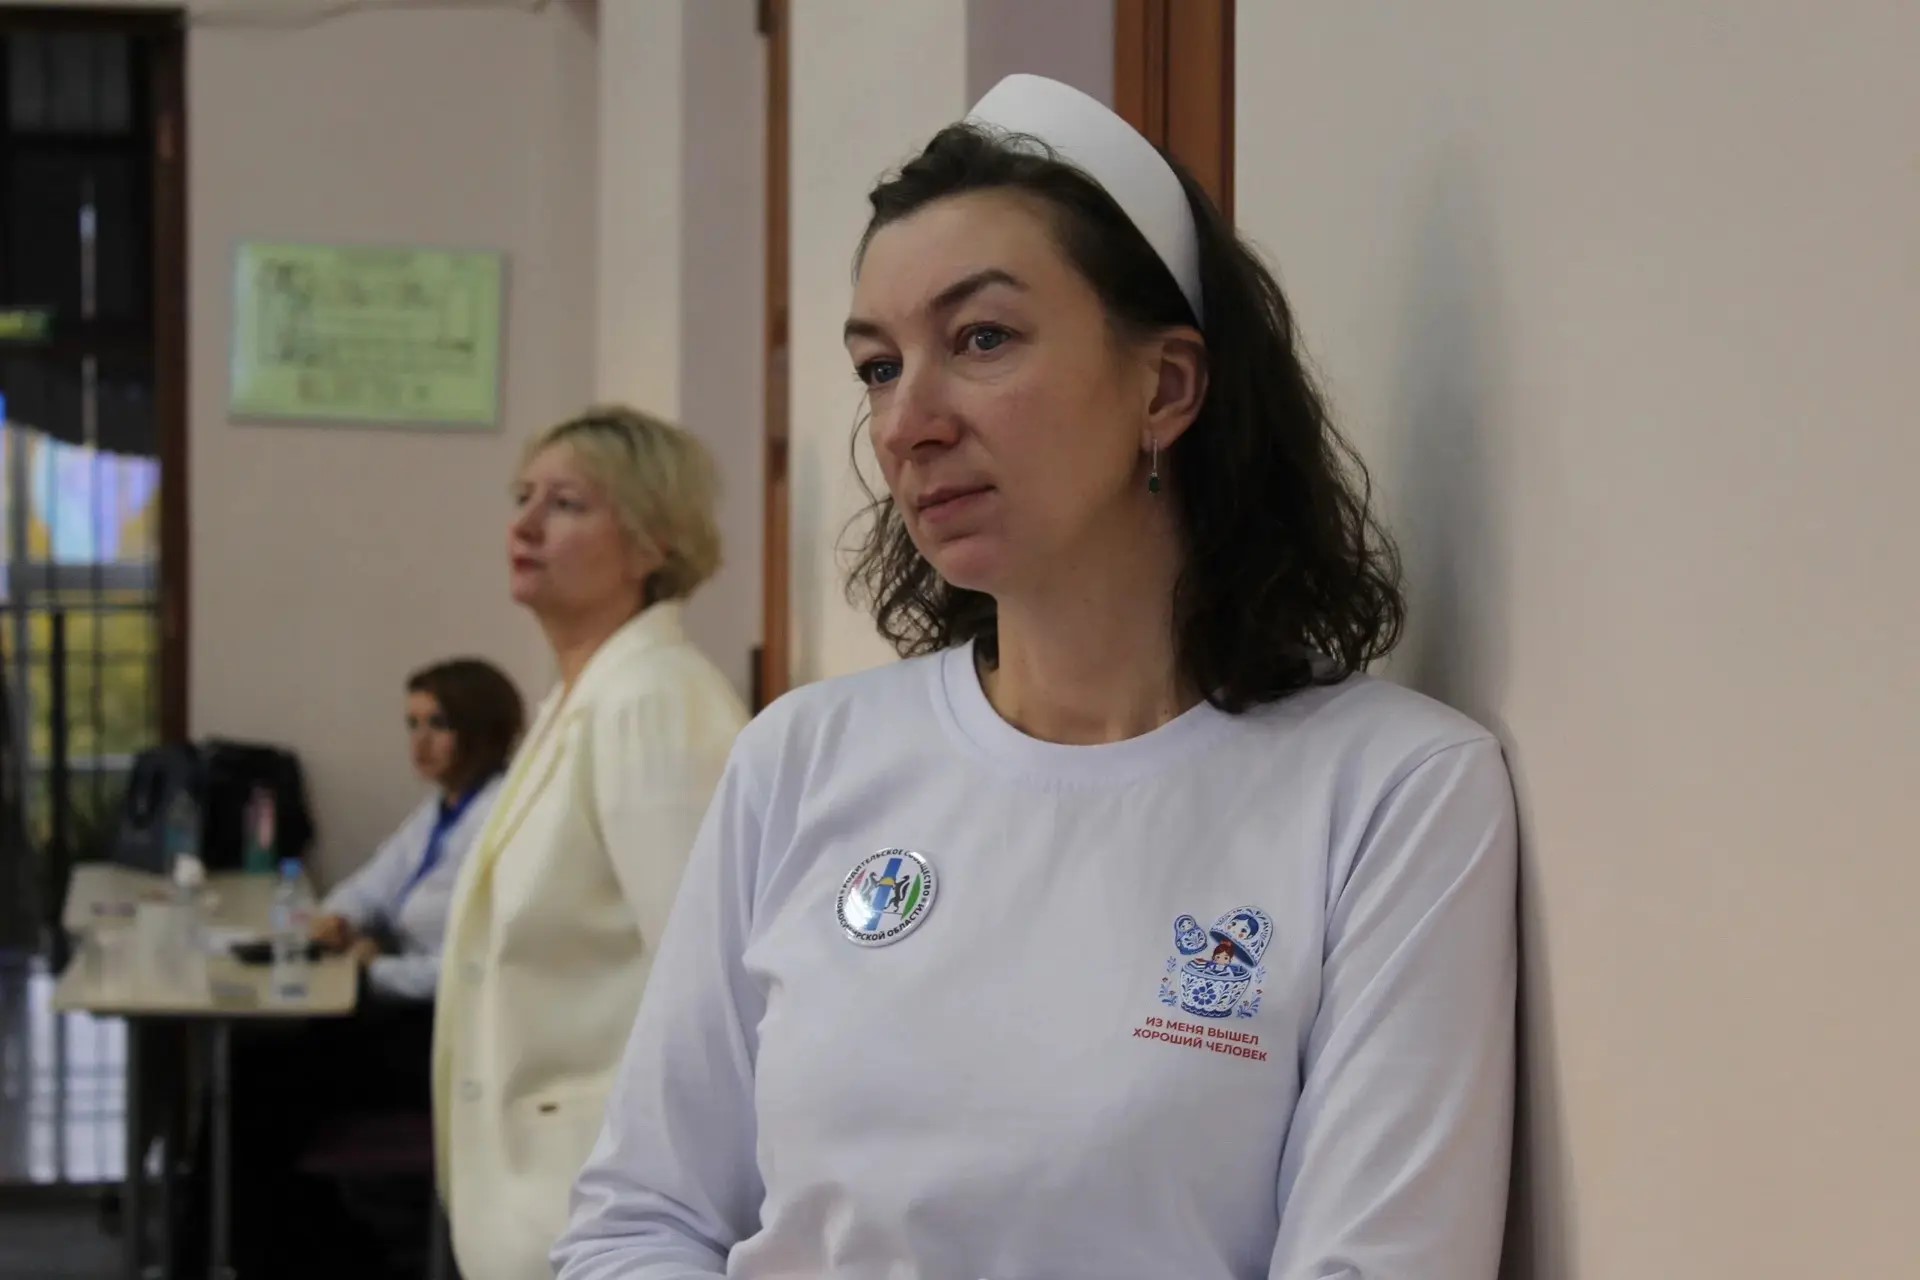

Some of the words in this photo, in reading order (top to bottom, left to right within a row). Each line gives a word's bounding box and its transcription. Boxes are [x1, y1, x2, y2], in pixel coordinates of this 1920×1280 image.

[886, 903, 925, 937] ОБЛАСТИ
[1132, 1027, 1203, 1049] ХОРОШИЙ
[1206, 1041, 1268, 1062] ЧЕЛОВЕК
[1145, 1016, 1163, 1028] ИЗ
[1166, 1020, 1204, 1035] МЕНЯ
[1207, 1027, 1259, 1046] ВЫШЕЛ
